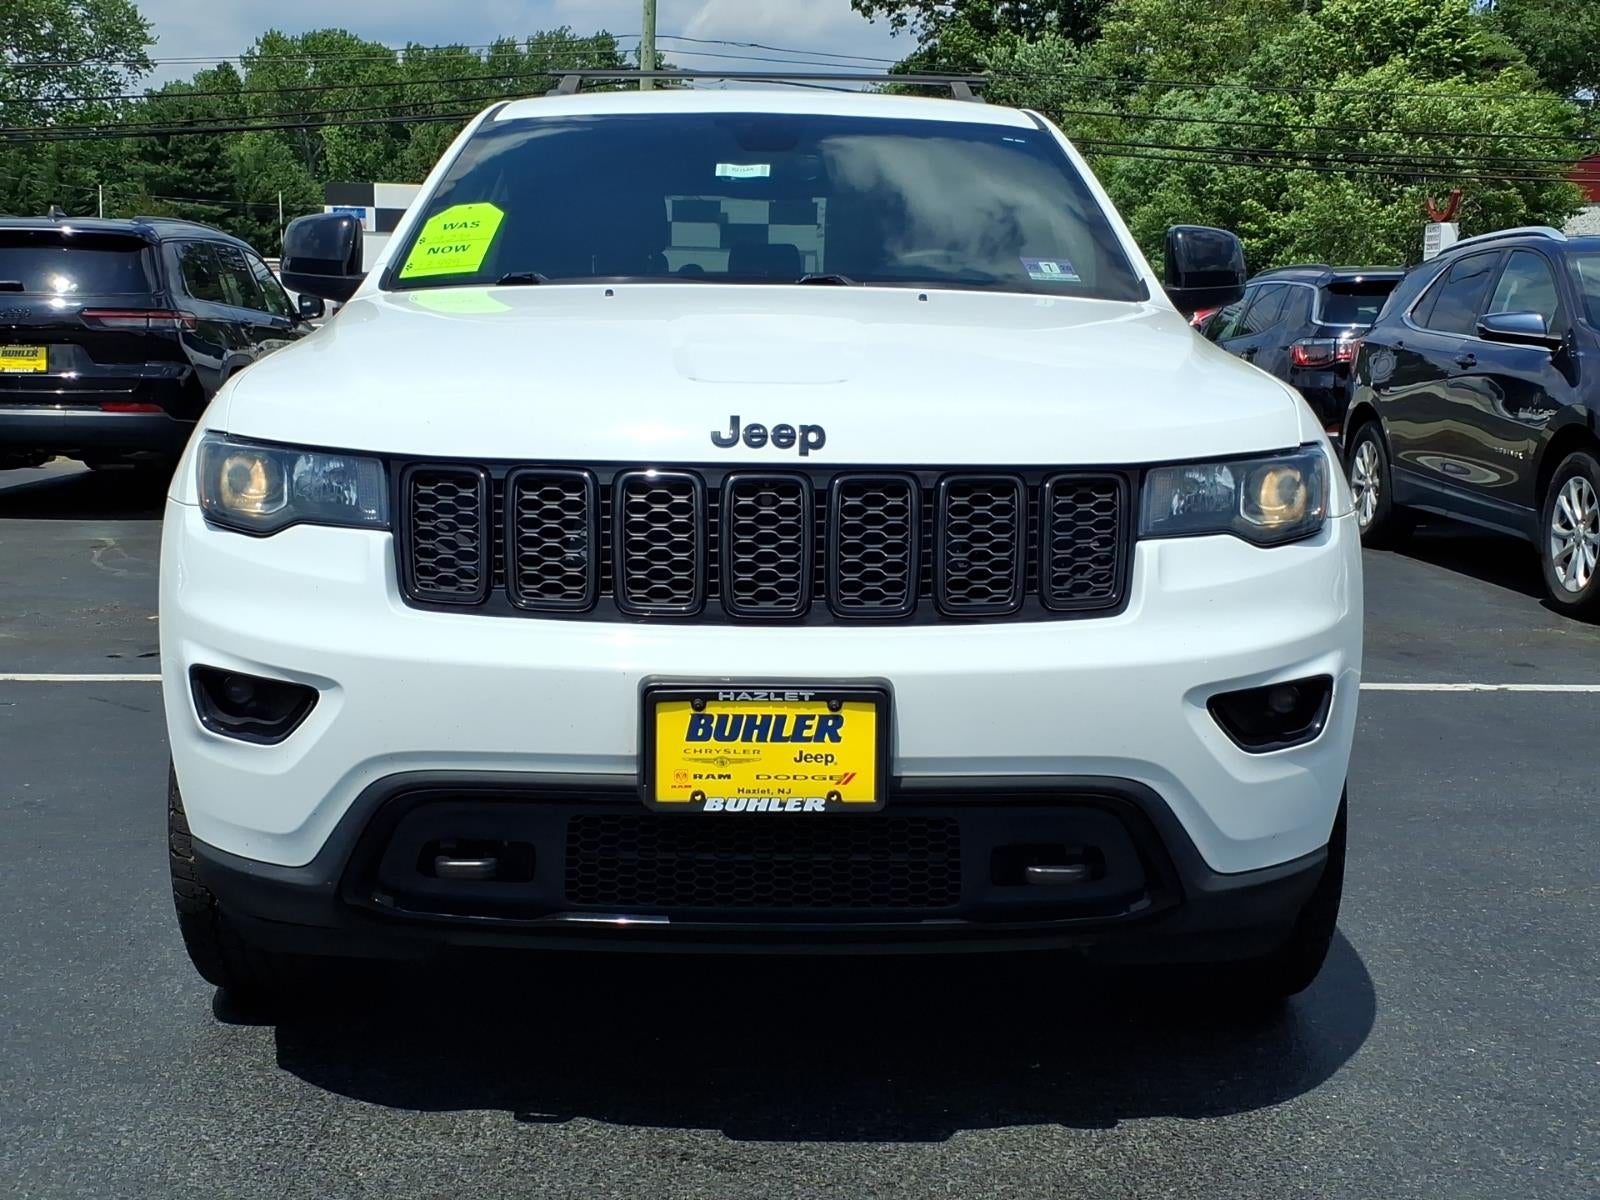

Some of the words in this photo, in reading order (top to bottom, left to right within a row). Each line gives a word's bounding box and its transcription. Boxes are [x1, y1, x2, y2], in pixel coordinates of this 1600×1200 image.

[443, 220, 481, 231] WAS
[426, 244, 471, 255] NOW
[710, 415, 826, 457] Jeep
[718, 691, 815, 701] HAZLET
[685, 713, 844, 743] BUHLER
[793, 750, 835, 766] Jeep
[755, 773, 843, 781] DODGE
[737, 787, 774, 795] Hazlet,
[777, 787, 792, 795] NJ
[703, 797, 826, 812] BUHLER
